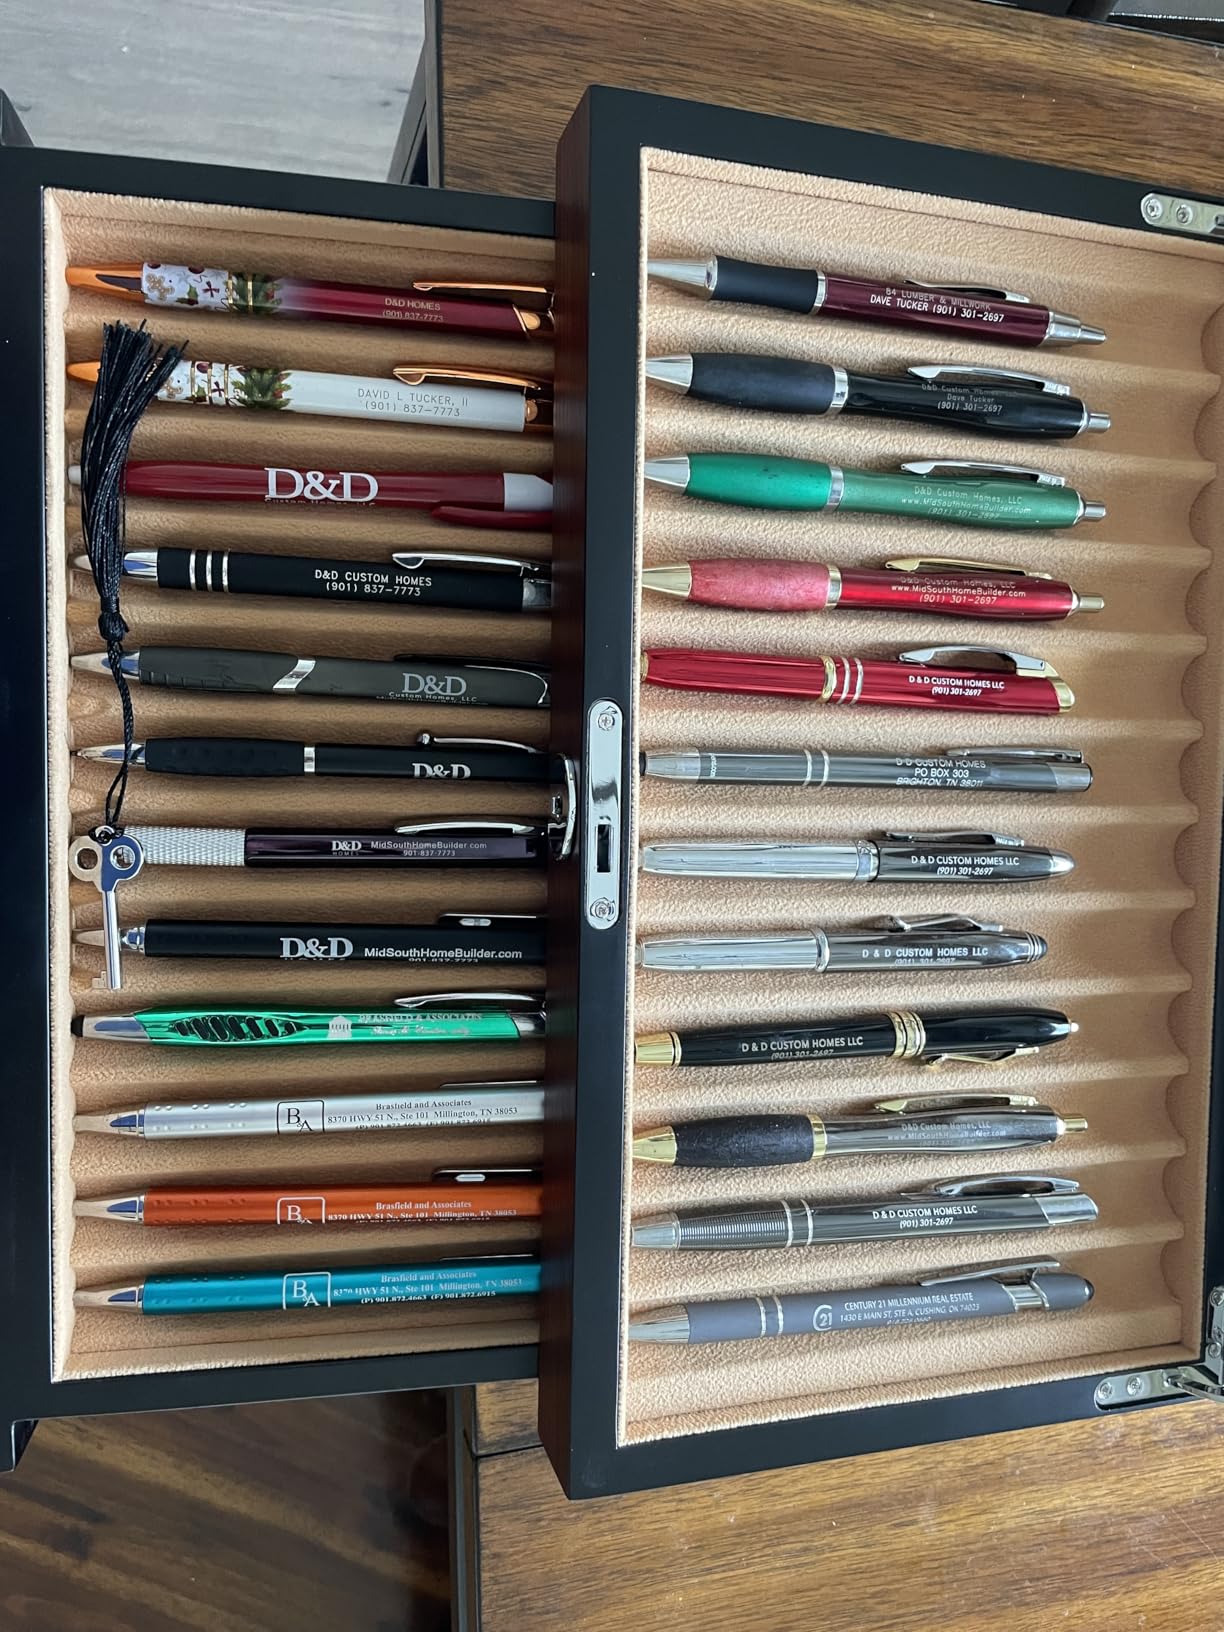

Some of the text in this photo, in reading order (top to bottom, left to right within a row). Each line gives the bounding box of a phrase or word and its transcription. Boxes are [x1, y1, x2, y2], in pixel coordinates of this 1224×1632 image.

[385, 298, 440, 311] D&D HOMES
[902, 290, 935, 302] LUMBER
[951, 297, 991, 310] MILLWORK
[870, 294, 1004, 322] DAVE TUCKER (901) 301-2697
[383, 310, 444, 322] (901) 837-7773
[358, 388, 389, 400] DAVID
[397, 392, 402, 400] L
[410, 393, 454, 406] TUCKER,
[365, 401, 460, 417] (901) 837-7773
[937, 402, 1002, 415] (901) 301-2697
[264, 467, 378, 502] D&D
[914, 486, 932, 495] D&D
[937, 488, 968, 499] Custom
[1008, 496, 1022, 505] LLC
[315, 569, 432, 587] D&D CUSTOM HOMES
[326, 582, 421, 596] (901) 837-7773
[891, 585, 1026, 597] www.MidSouthHomeBuilder.com
[920, 594, 997, 605] (901) 301-2697
[402, 673, 466, 695] D&D
[931, 677, 962, 686] CUSTOM
[964, 679, 990, 688] HOMES
[992, 681, 1005, 689] LLC
[932, 686, 982, 696] (901) 301-2697
[915, 759, 953, 768] CUSTOM
[956, 760, 986, 768] HOMES
[412, 763, 471, 779] D&D
[915, 768, 969, 778] PO BOX 303
[332, 840, 361, 851] D&D
[371, 841, 487, 849] MidSouthHomeBuilder.com
[911, 856, 1020, 866] D & D CUSTOM HOMES LLC
[937, 867, 994, 875] (901) 301-2697
[280, 937, 523, 959] D&D MidSouthHomeBuilder.com
[862, 947, 989, 958] D & D CUSTOM HOMES LLC
[741, 1036, 863, 1052] D & D CUSTOM HOMES LLC
[376, 1100, 472, 1110] Brasfield and Associates
[350, 1114, 372, 1122] HWY
[400, 1112, 413, 1120] Ste
[434, 1110, 478, 1118] Millington,
[480, 1108, 493, 1116] TN
[495, 1106, 518, 1115] 38053
[376, 1201, 412, 1210] Brasfield
[414, 1201, 430, 1209] and
[872, 1205, 978, 1219] D & D CUSTOM HOMES LLC
[900, 1217, 954, 1229] (901) 301-2697
[420, 1273, 434, 1281] and
[437, 1271, 477, 1280] Associates
[421, 1284, 434, 1292] 101
[439, 1282, 482, 1291] Millington,
[844, 1292, 974, 1311] CENTURY 21 MILLENNIUM REAL ESTATE
[840, 1314, 857, 1322] 1430
[864, 1311, 882, 1320] MAIN
[894, 1309, 906, 1318] STE
[949, 1305, 959, 1313] OK
